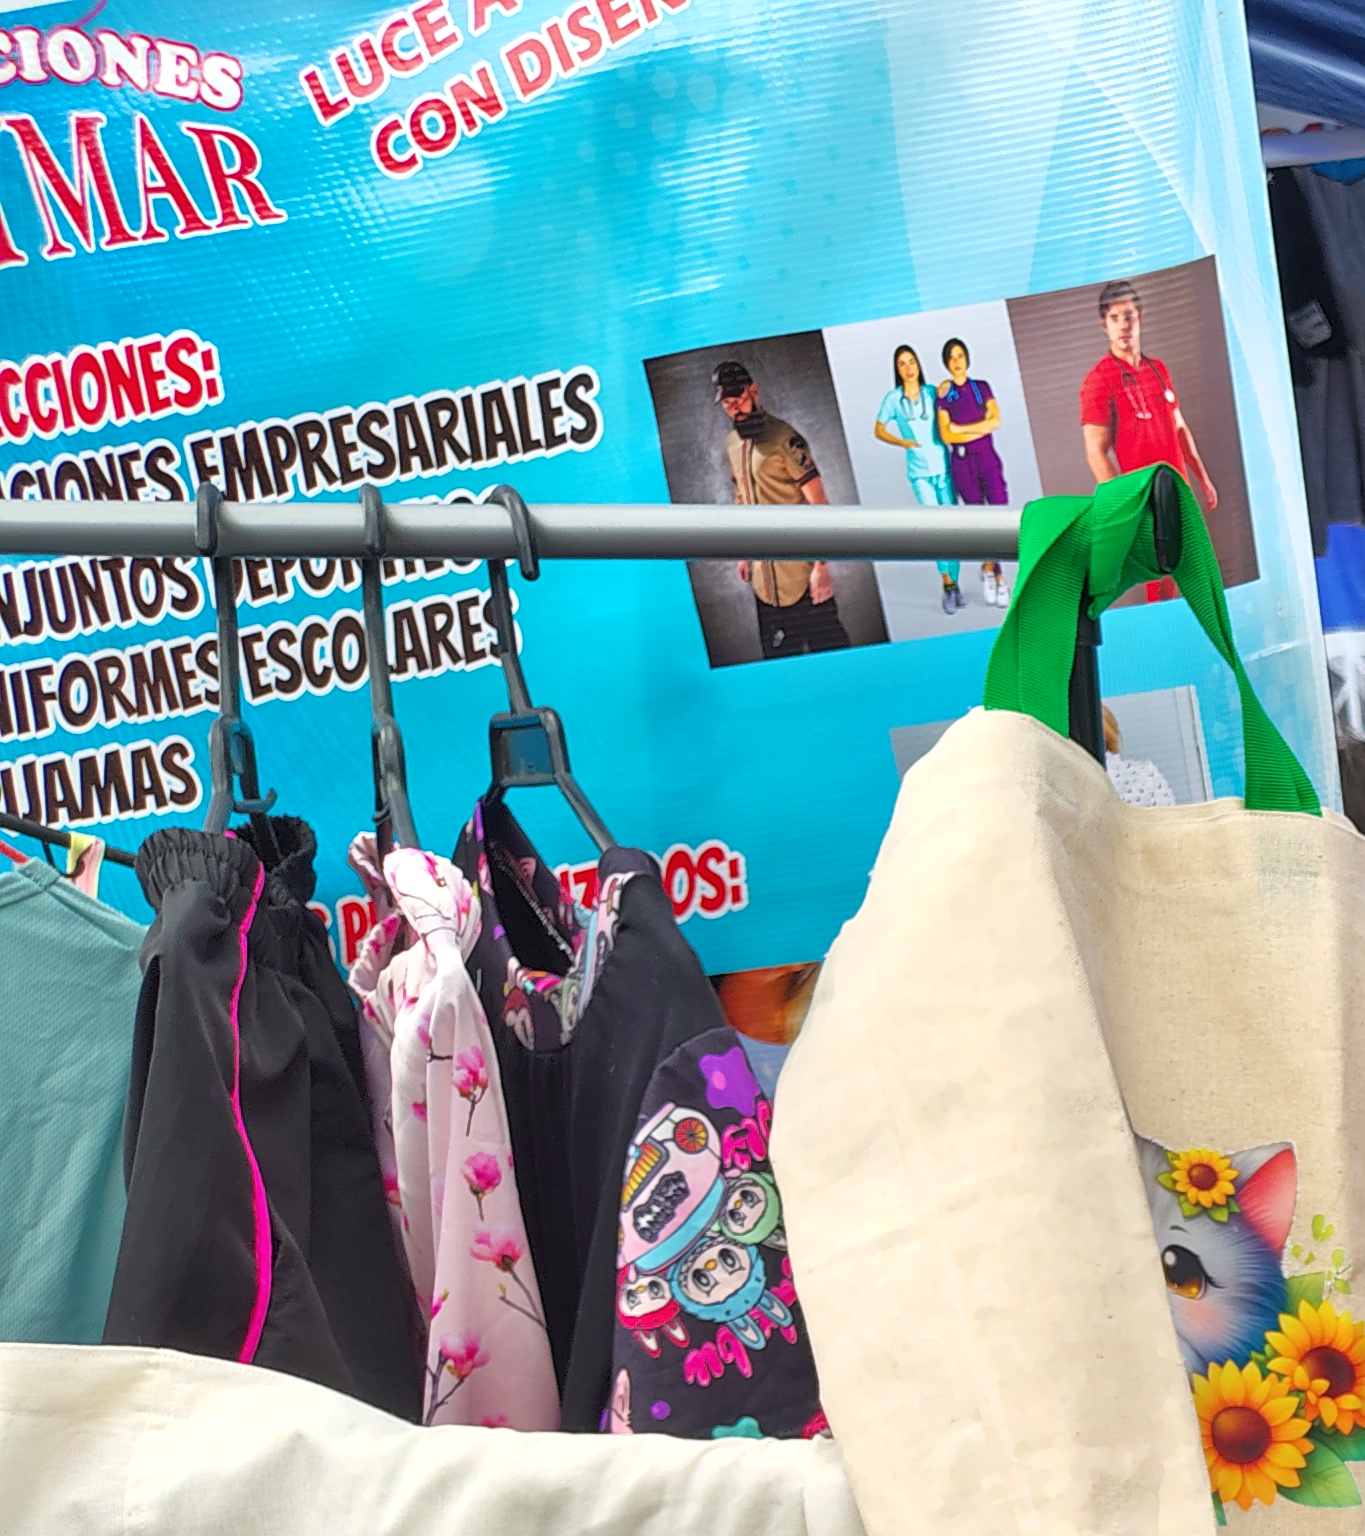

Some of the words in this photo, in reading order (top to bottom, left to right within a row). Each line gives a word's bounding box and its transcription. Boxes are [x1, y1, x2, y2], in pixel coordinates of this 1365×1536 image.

[304, 0, 459, 123] LUCE
[374, 66, 505, 176] CON
[0, 115, 286, 262] MAR
[0, 336, 219, 439] CCIONES:
[190, 372, 598, 501] EMPRESARIALES
[240, 595, 508, 700] ESCOARE
